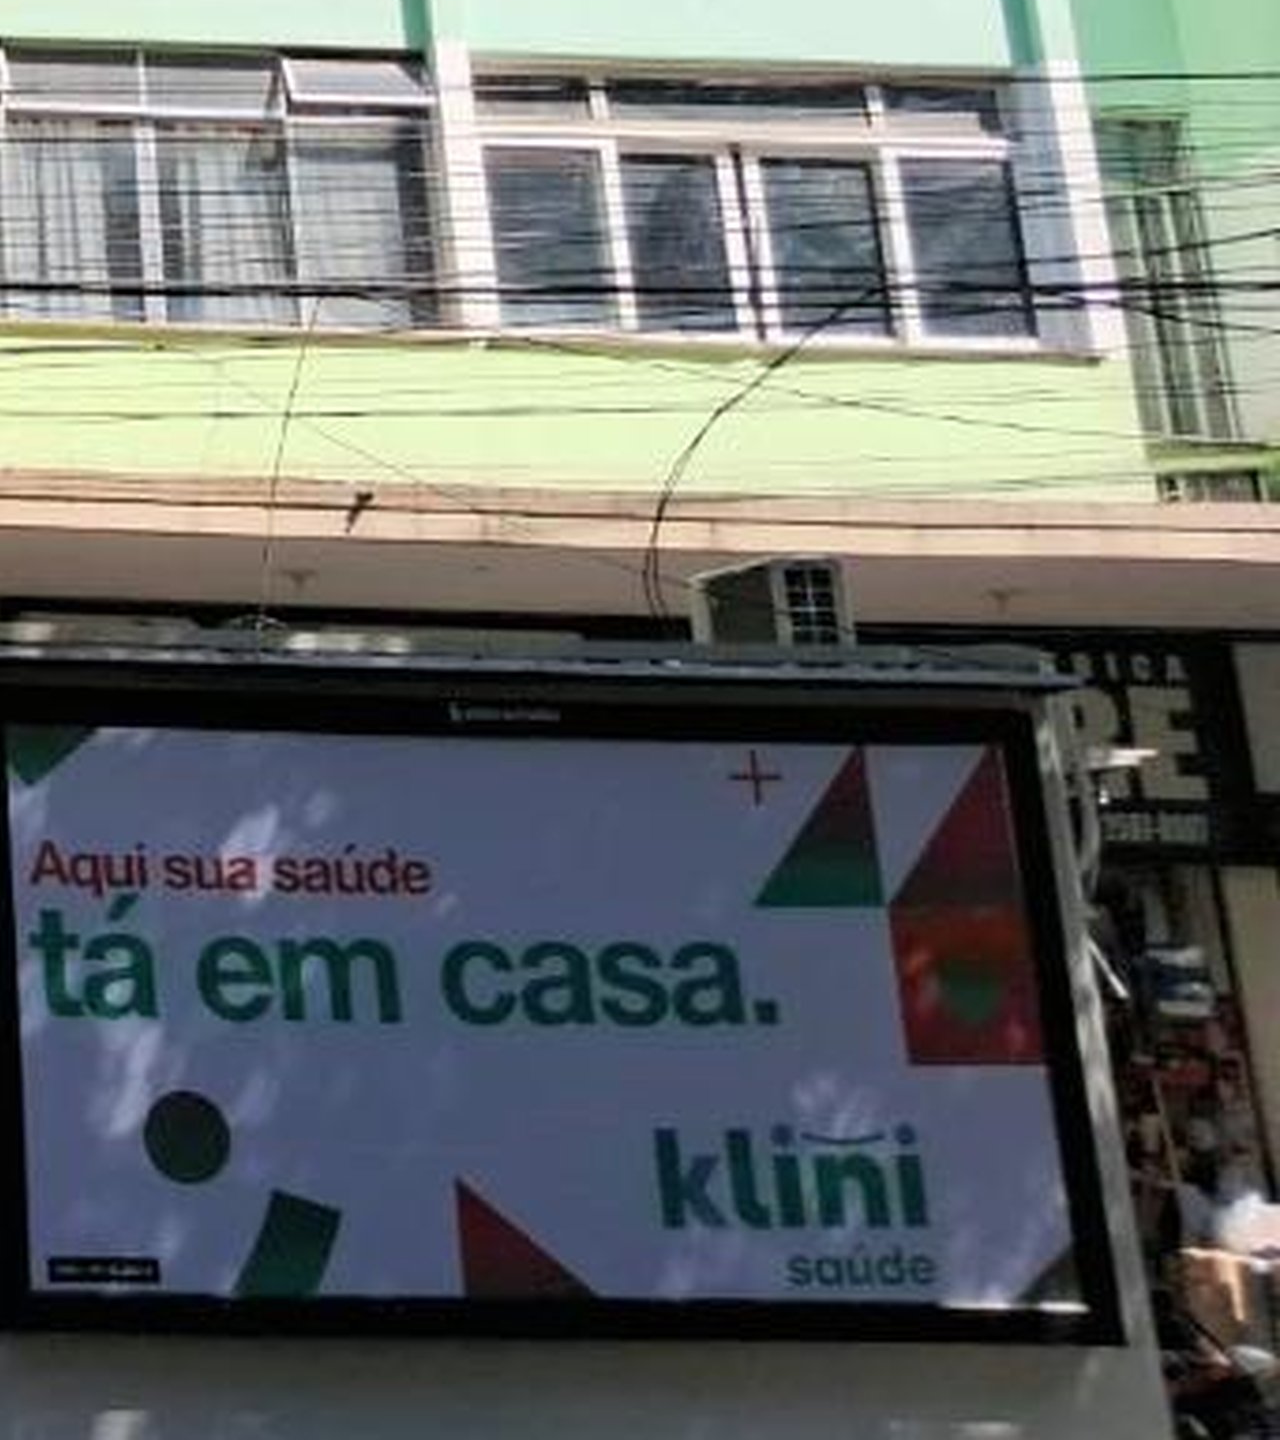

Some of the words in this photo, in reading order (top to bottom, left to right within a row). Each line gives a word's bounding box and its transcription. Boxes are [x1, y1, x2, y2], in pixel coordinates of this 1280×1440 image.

[30, 839, 148, 896] Aqui
[163, 855, 259, 891] sua
[272, 844, 432, 895] saúde
[28, 893, 160, 1020] tá
[196, 935, 403, 1024] em
[441, 940, 780, 1027] casa.
[653, 1123, 928, 1231] klini
[789, 1242, 935, 1288] saúde
